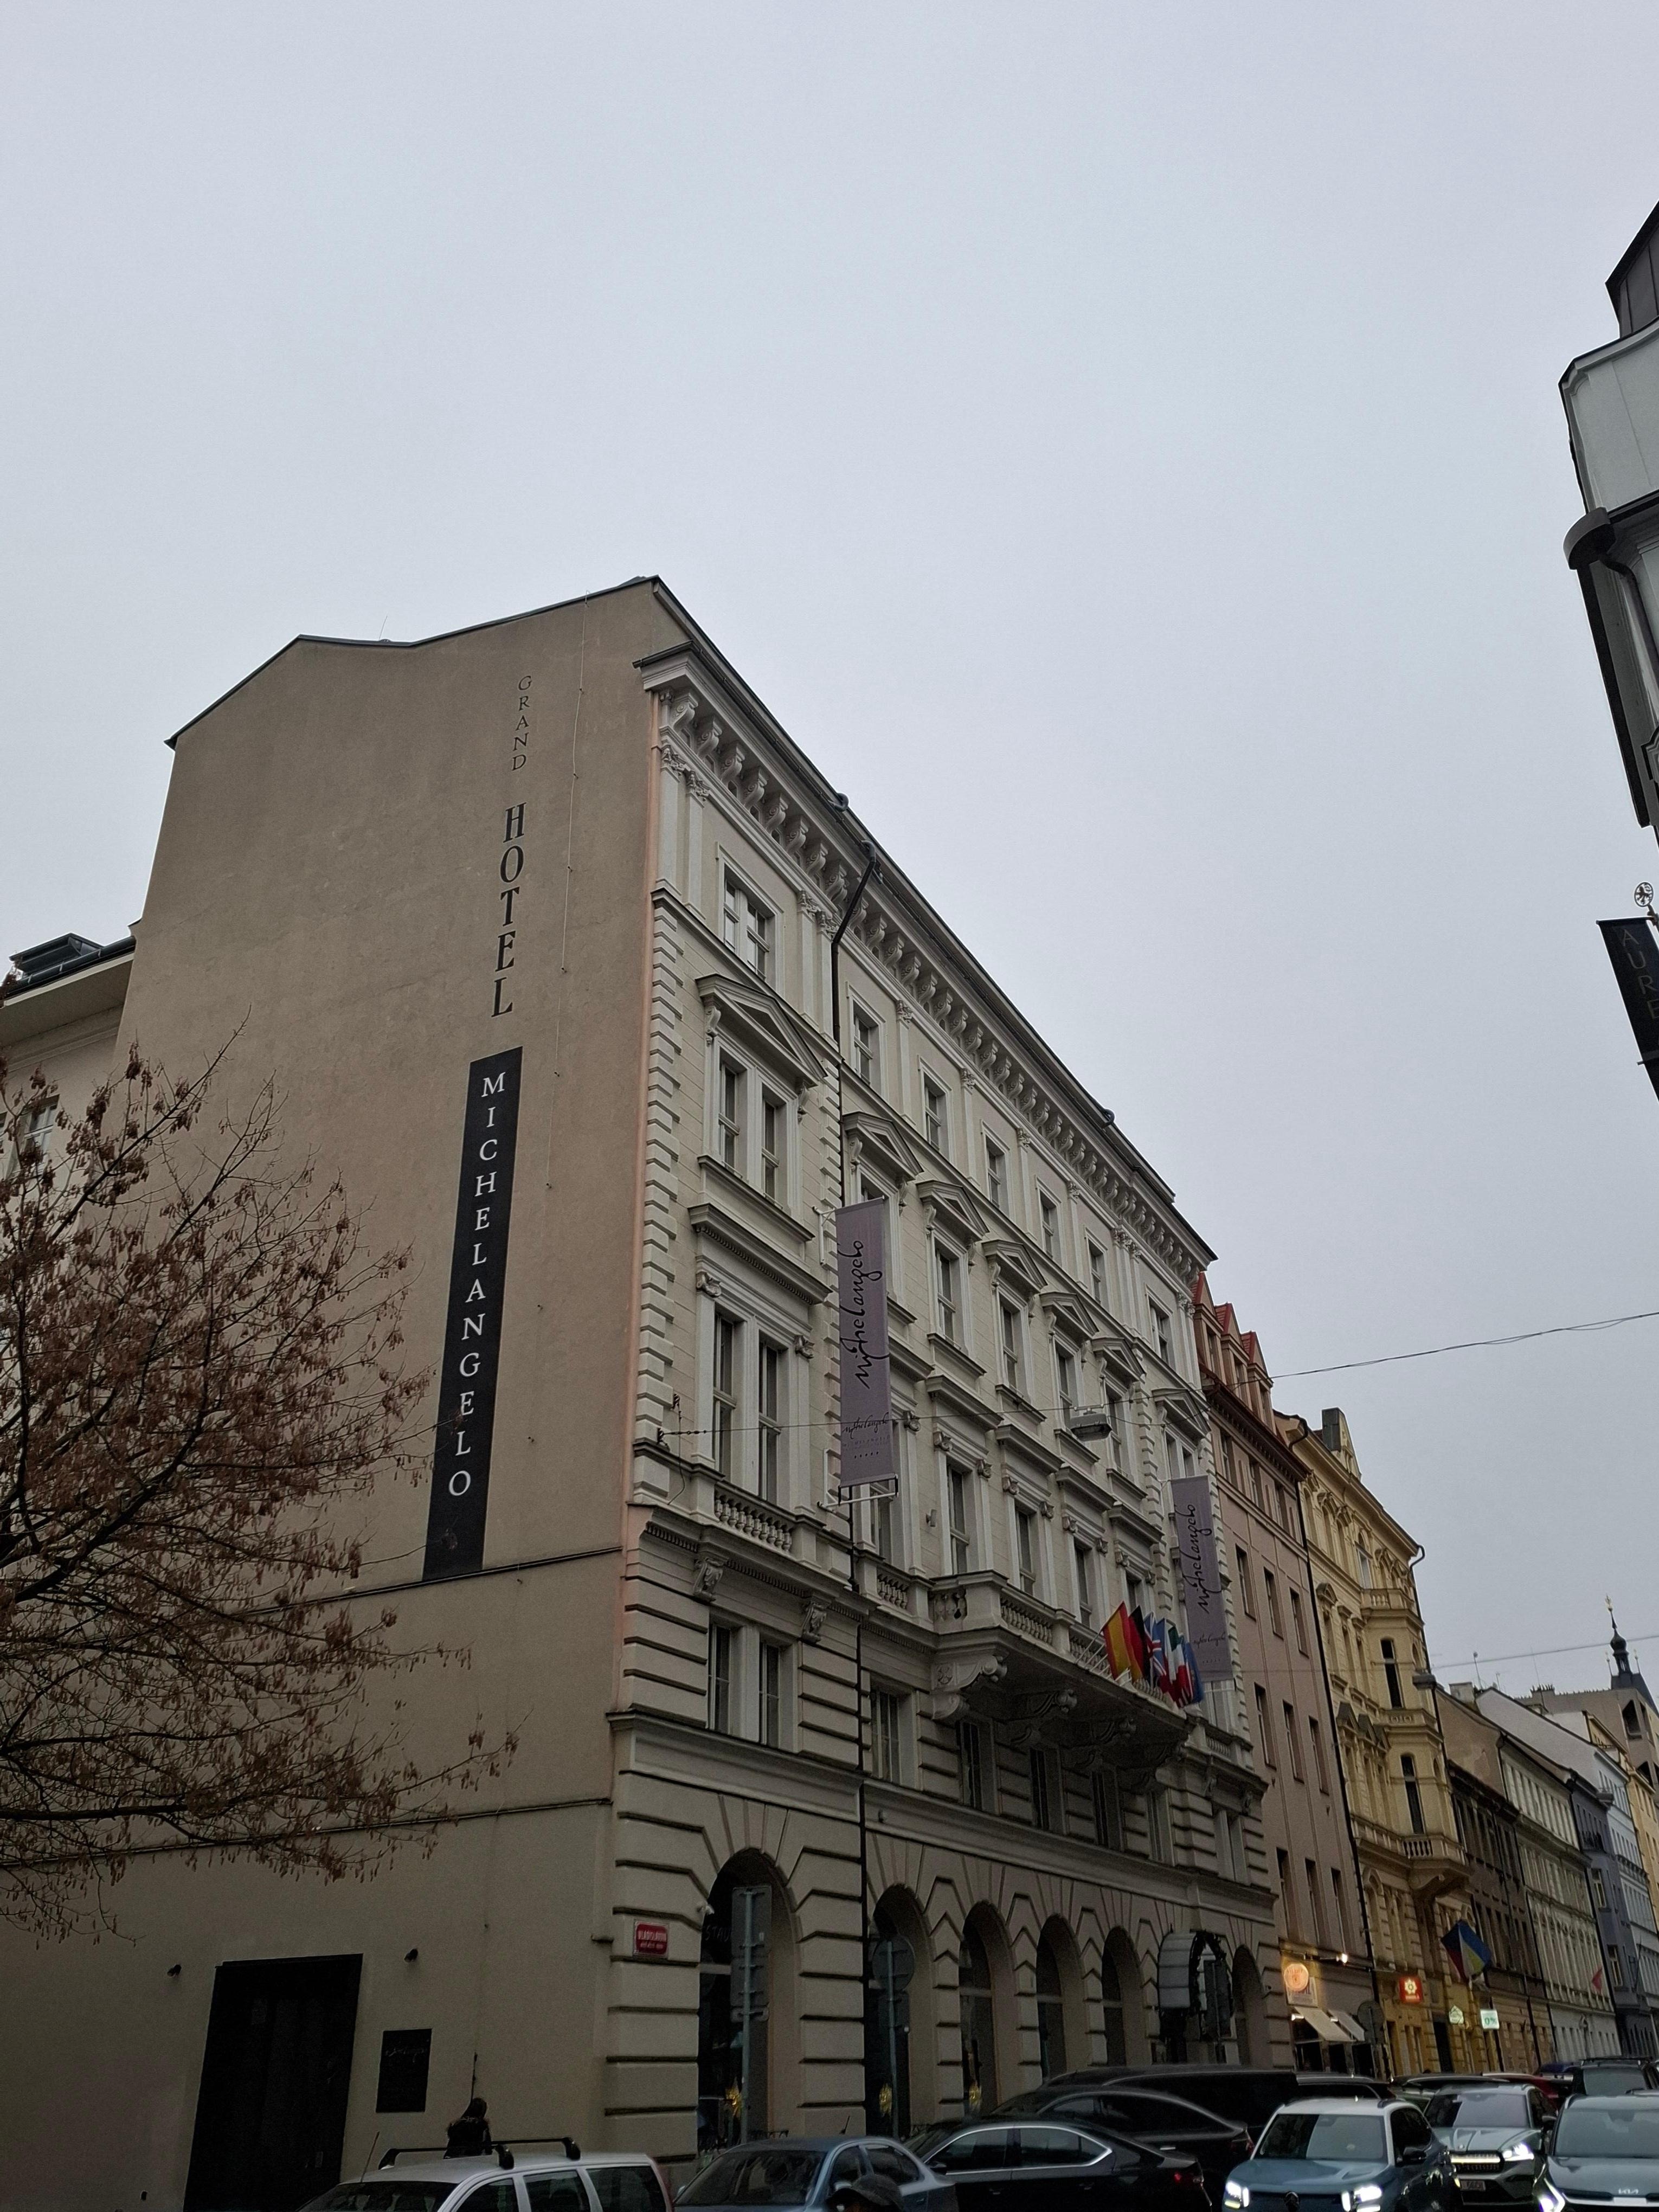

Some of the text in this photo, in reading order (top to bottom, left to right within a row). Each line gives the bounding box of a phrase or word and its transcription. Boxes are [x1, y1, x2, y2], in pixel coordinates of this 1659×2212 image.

[491, 675, 532, 1018] GRAND HOTEL
[448, 1072, 506, 1497] MICHELANGELO
